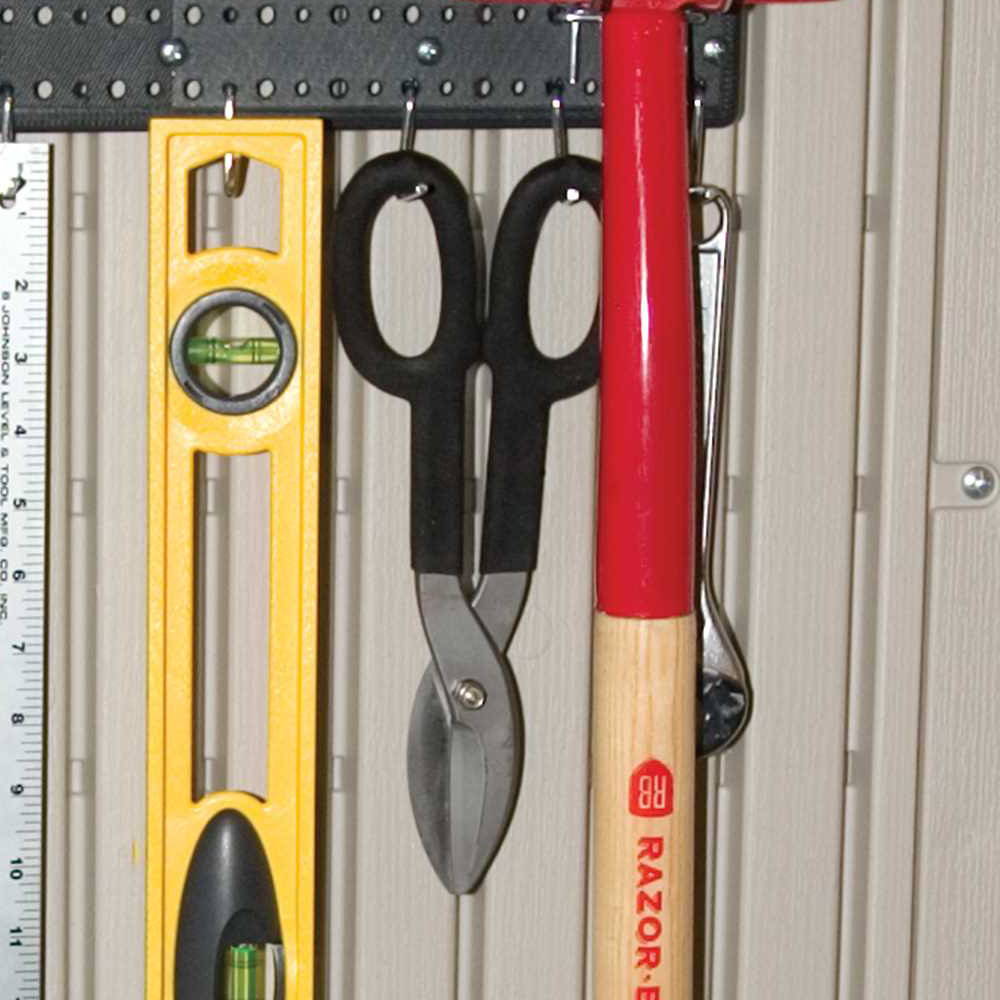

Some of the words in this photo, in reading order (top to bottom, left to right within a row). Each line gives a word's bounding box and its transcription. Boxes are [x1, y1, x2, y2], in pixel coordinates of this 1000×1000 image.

[14, 280, 29, 292] 2
[0, 304, 10, 386] JOHNSON
[14, 352, 28, 364] 3
[0, 391, 10, 440] LEVEL
[13, 425, 27, 437] 4
[0, 464, 9, 506] TOOL
[13, 498, 27, 510] 5
[12, 570, 26, 582] 6
[0, 593, 8, 625] INC.
[12, 641, 26, 653] 7
[11, 713, 25, 725] 8
[10, 783, 24, 796] 9
[9, 857, 24, 880] 10
[9, 926, 23, 947] 11
